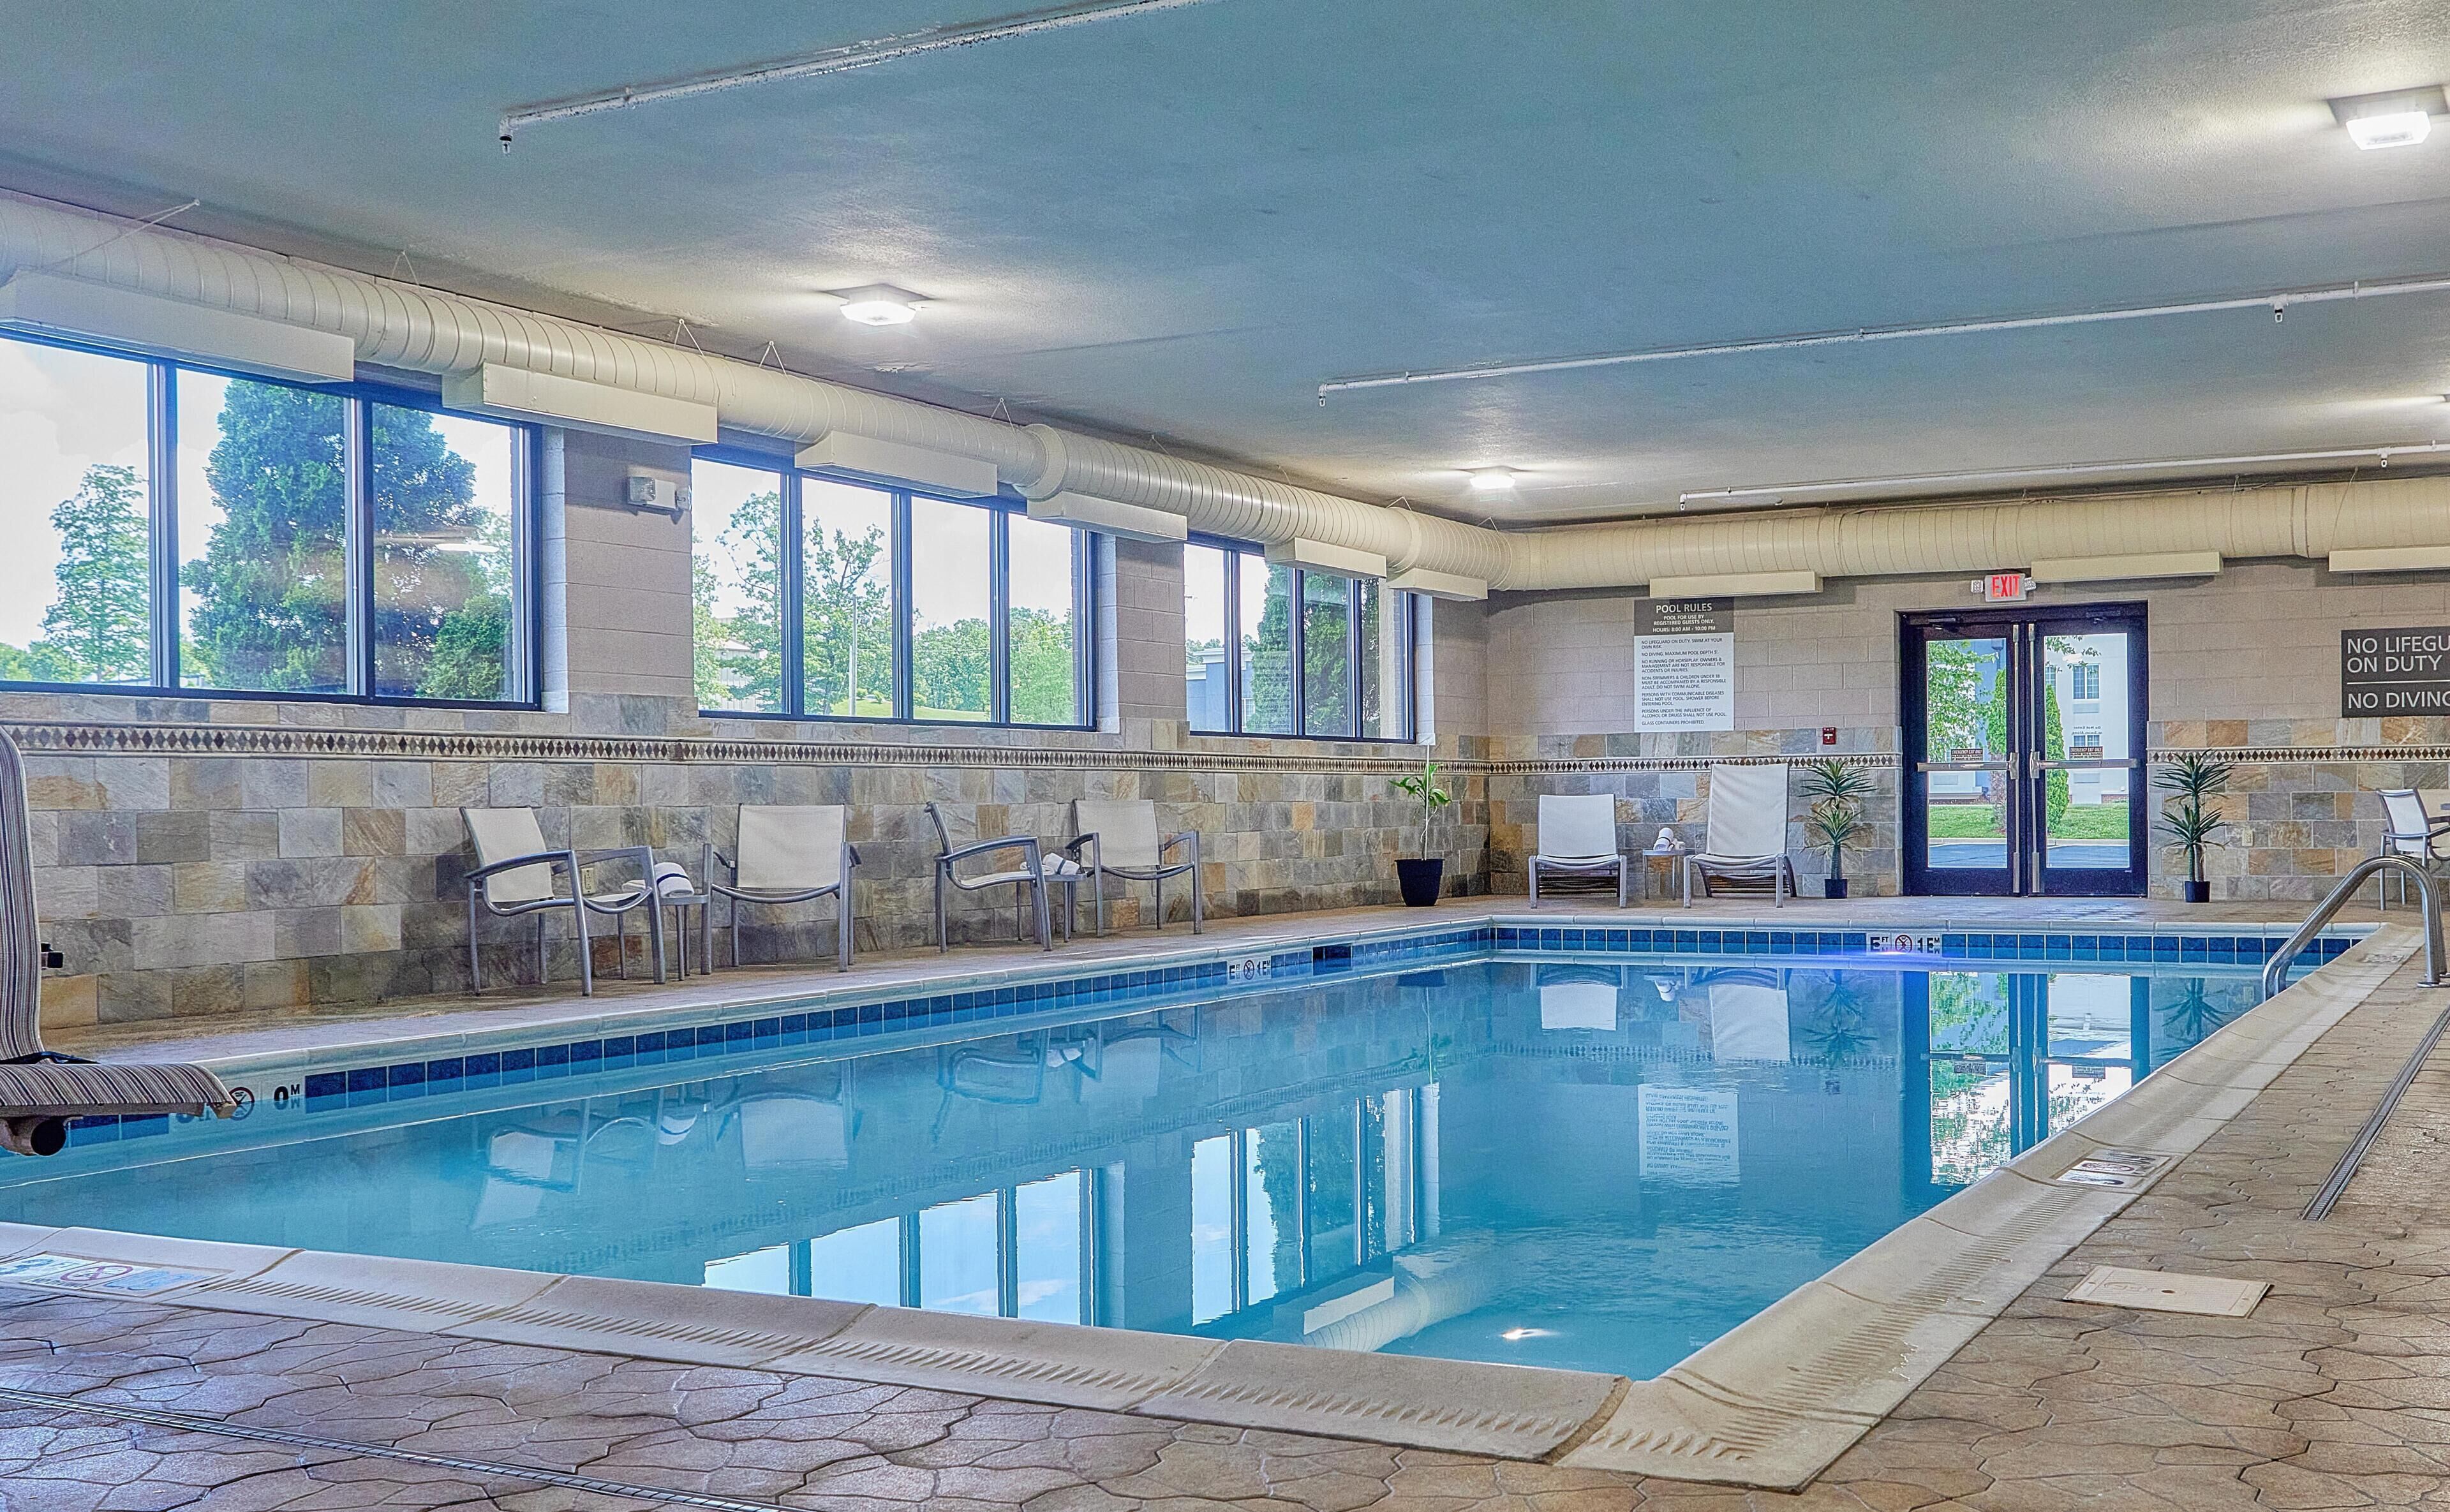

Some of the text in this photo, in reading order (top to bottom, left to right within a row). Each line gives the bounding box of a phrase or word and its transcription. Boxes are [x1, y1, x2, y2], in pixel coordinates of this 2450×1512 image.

[1992, 575, 2021, 597] EXIT
[1656, 604, 1712, 613] POOL RULES
[2347, 635, 2450, 654] NO LIFEGU
[2347, 655, 2442, 673] ON DUTY
[2348, 693, 2378, 709] NO
[290, 1084, 300, 1095] M
